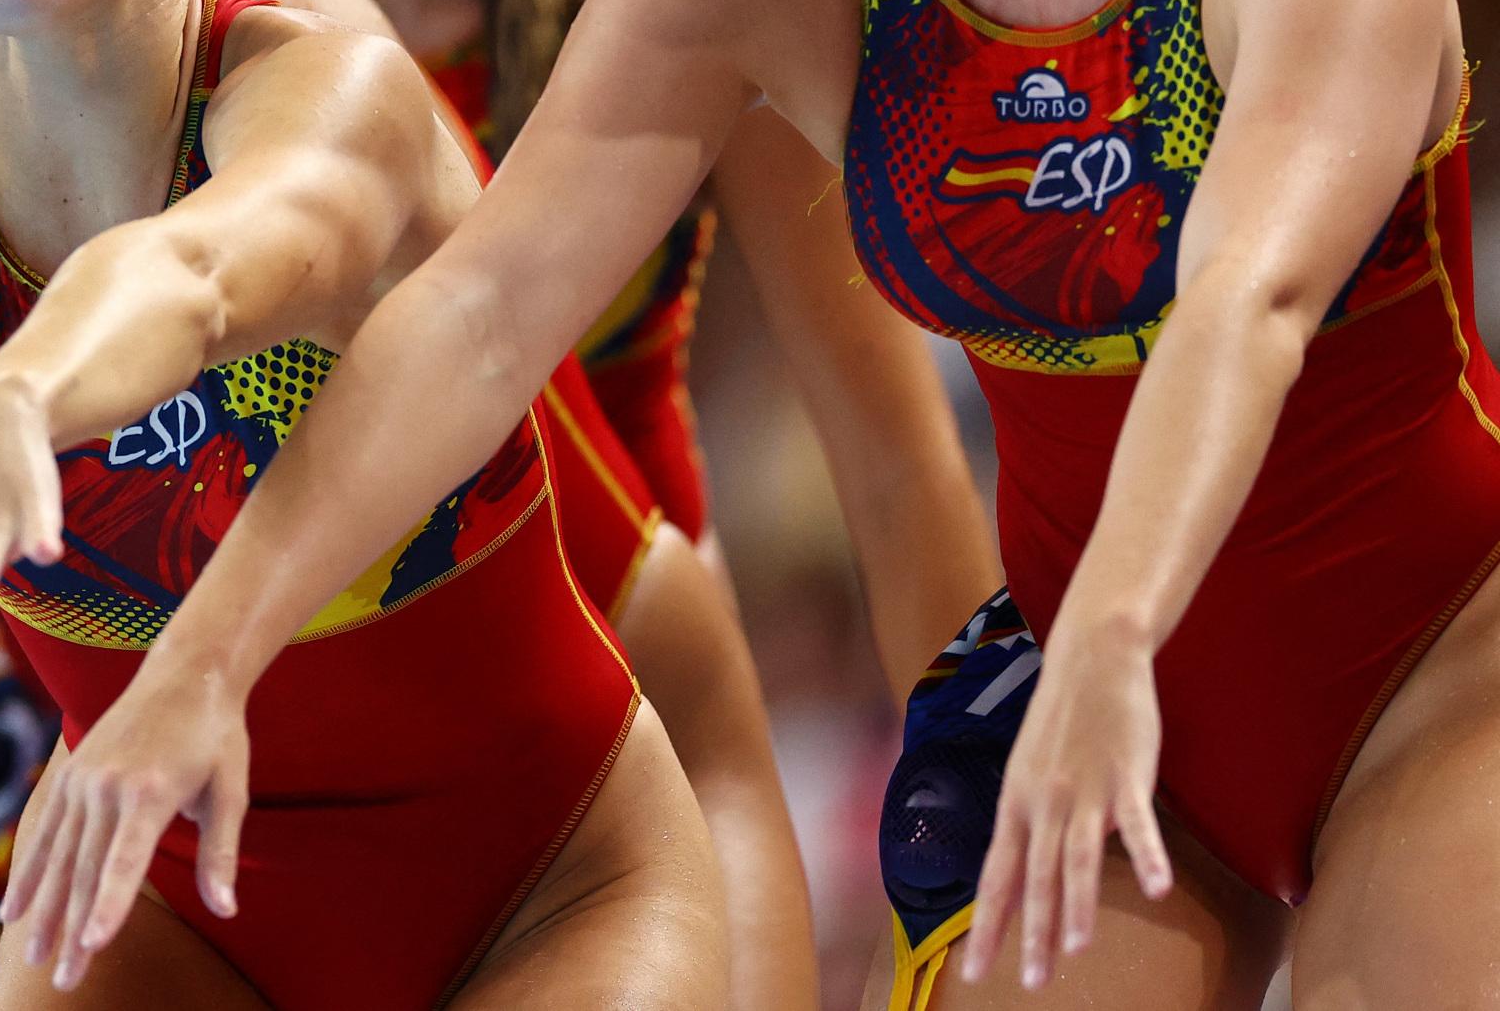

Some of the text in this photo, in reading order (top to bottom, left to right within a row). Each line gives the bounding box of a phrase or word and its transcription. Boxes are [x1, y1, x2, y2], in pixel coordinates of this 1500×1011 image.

[997, 97, 1086, 118] TURBO
[1025, 137, 1131, 211] ESP
[108, 390, 206, 466] ESP
